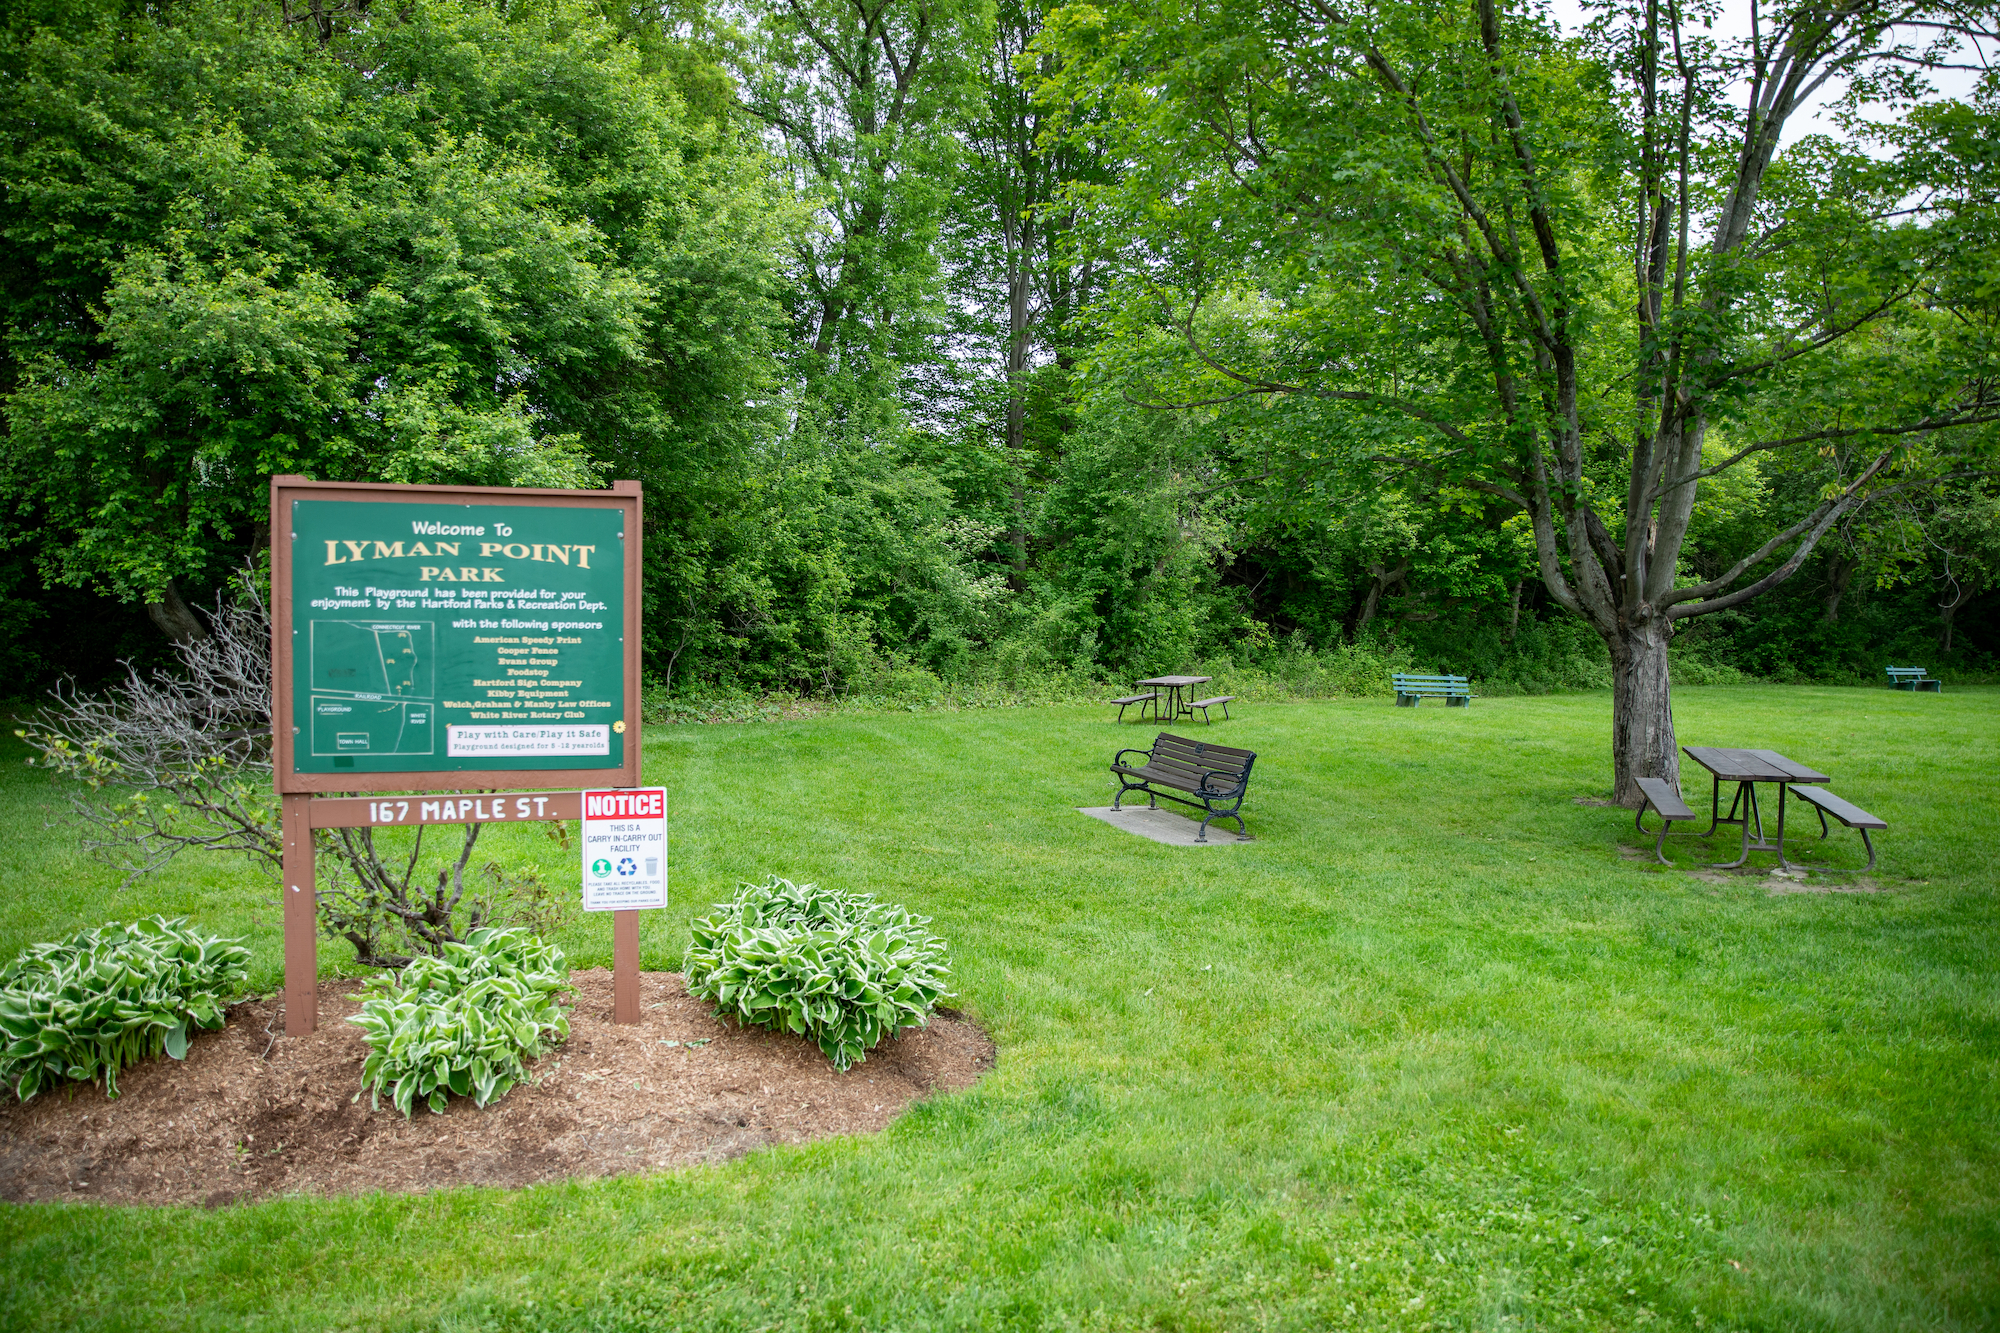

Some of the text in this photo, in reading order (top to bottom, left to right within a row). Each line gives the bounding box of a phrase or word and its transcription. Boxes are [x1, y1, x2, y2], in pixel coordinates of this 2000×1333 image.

[412, 521, 512, 537] Welcome To
[324, 541, 595, 568] LYMAN POINT
[420, 567, 505, 582] PARK
[335, 587, 586, 602] This Playground has been provided for your
[311, 598, 607, 613] enjoyment by the Hartford Parks & Recreation Dept.
[452, 619, 603, 632] with the following sponsors
[498, 647, 529, 655] Cooper
[540, 680, 582, 688] Company
[457, 731, 480, 740] Play
[370, 797, 557, 822] 167 MAPLE ST.
[588, 795, 662, 816] NOTICE
